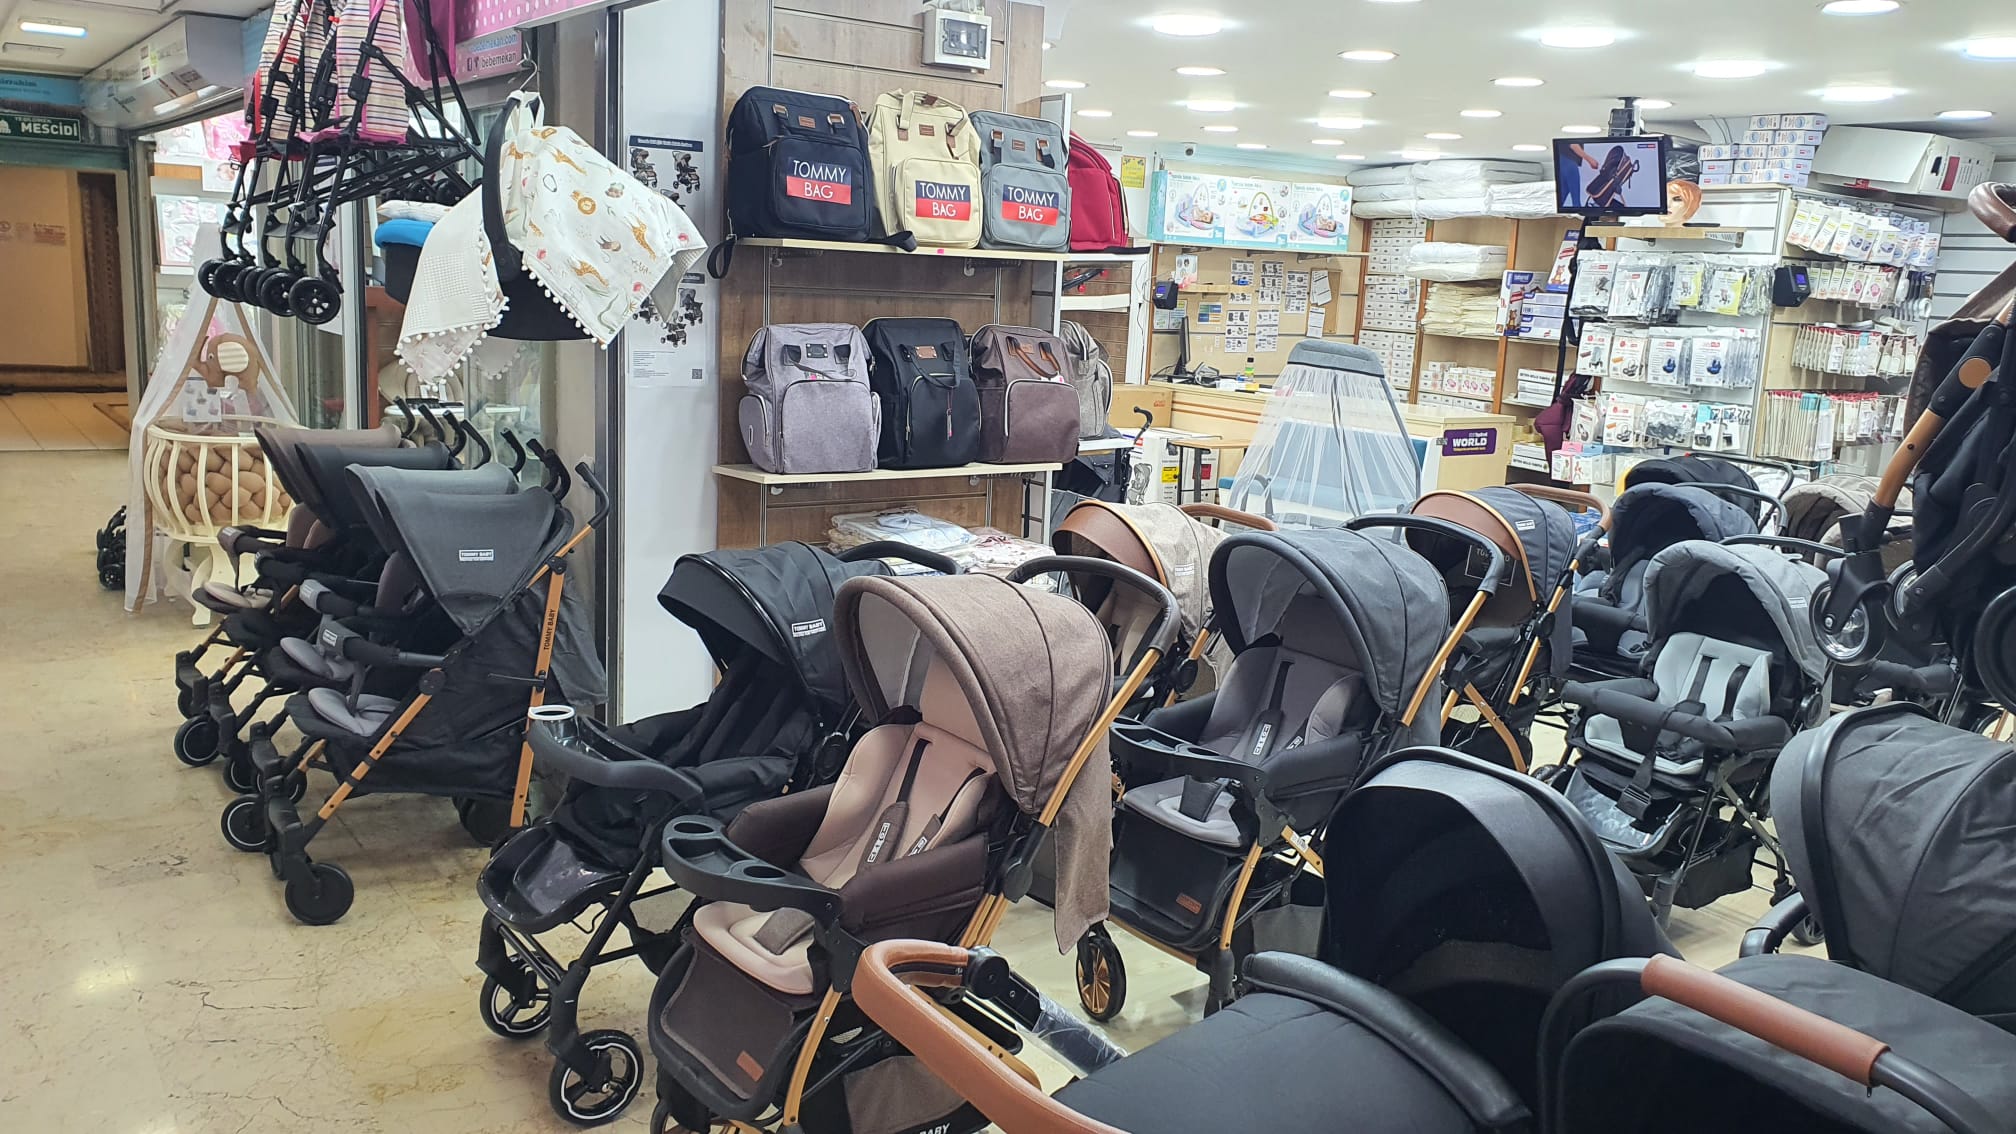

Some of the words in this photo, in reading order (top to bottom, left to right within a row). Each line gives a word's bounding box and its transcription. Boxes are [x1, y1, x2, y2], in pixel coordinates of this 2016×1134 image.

[482, 52, 517, 68] bebemekan
[21, 121, 78, 137] MESCİDİ
[793, 160, 847, 183] TOMMY
[804, 182, 834, 199] BAG
[919, 182, 966, 201] TOMMY
[1007, 186, 1055, 207] TOMMY
[932, 201, 957, 217] BAG
[1018, 205, 1044, 221] BAG
[1452, 437, 1488, 447] WORLD
[547, 608, 557, 626] BABY
[543, 627, 553, 651] TOMMY
